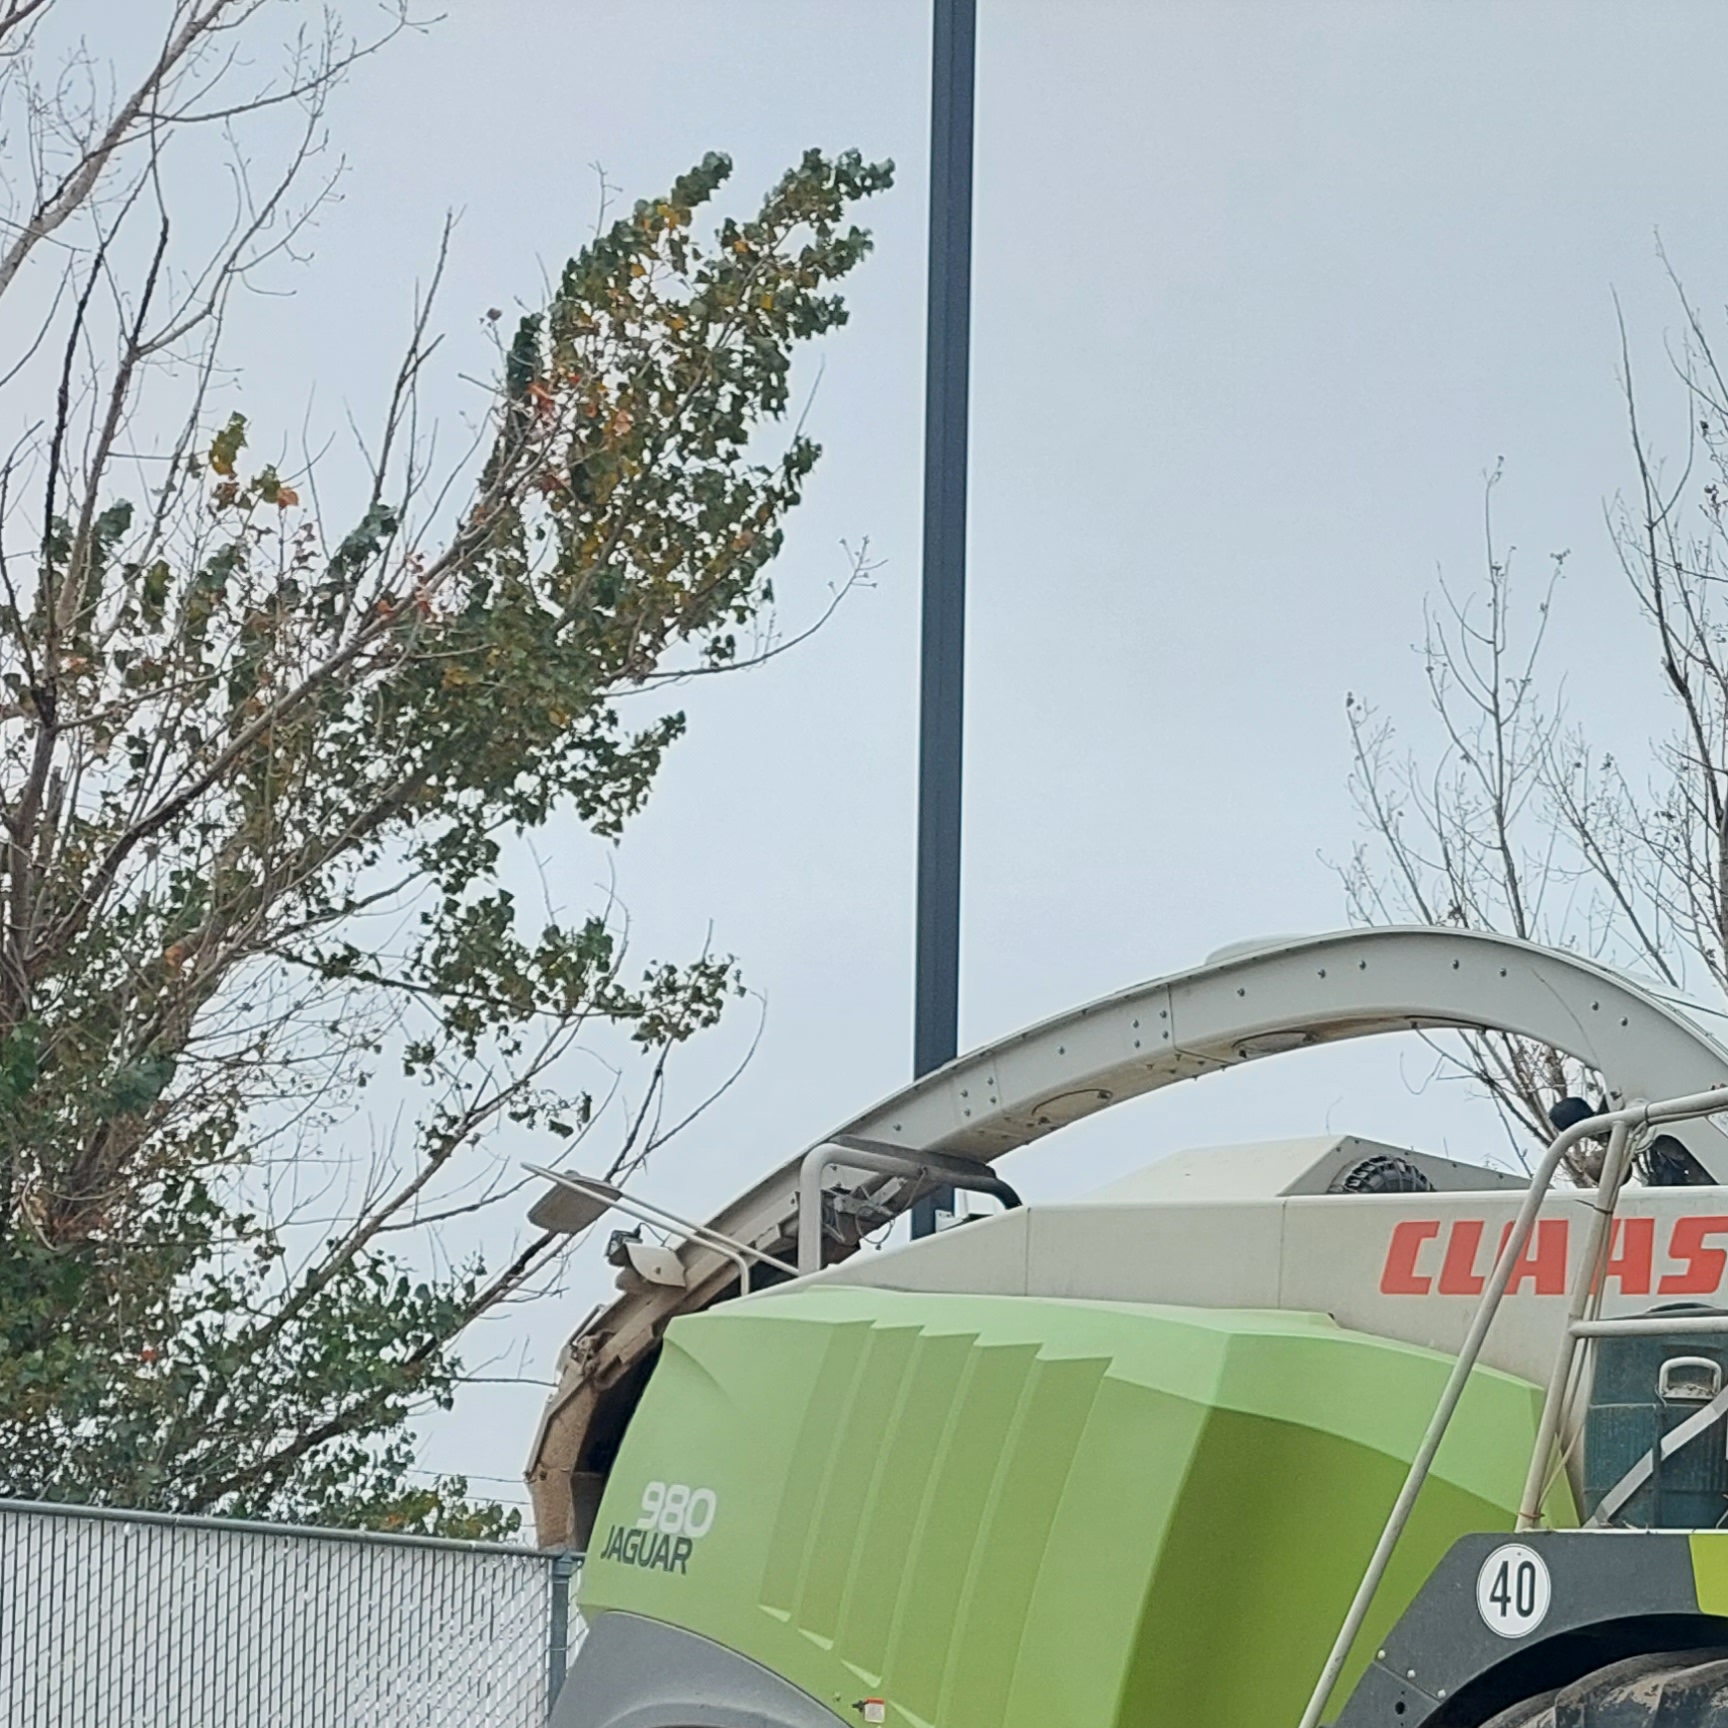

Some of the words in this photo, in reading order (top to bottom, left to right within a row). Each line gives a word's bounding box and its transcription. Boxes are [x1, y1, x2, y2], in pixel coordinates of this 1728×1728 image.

[636, 1481, 717, 1538] 980
[600, 1525, 693, 1575] JAGUAR
[1489, 1560, 1536, 1618] 40
